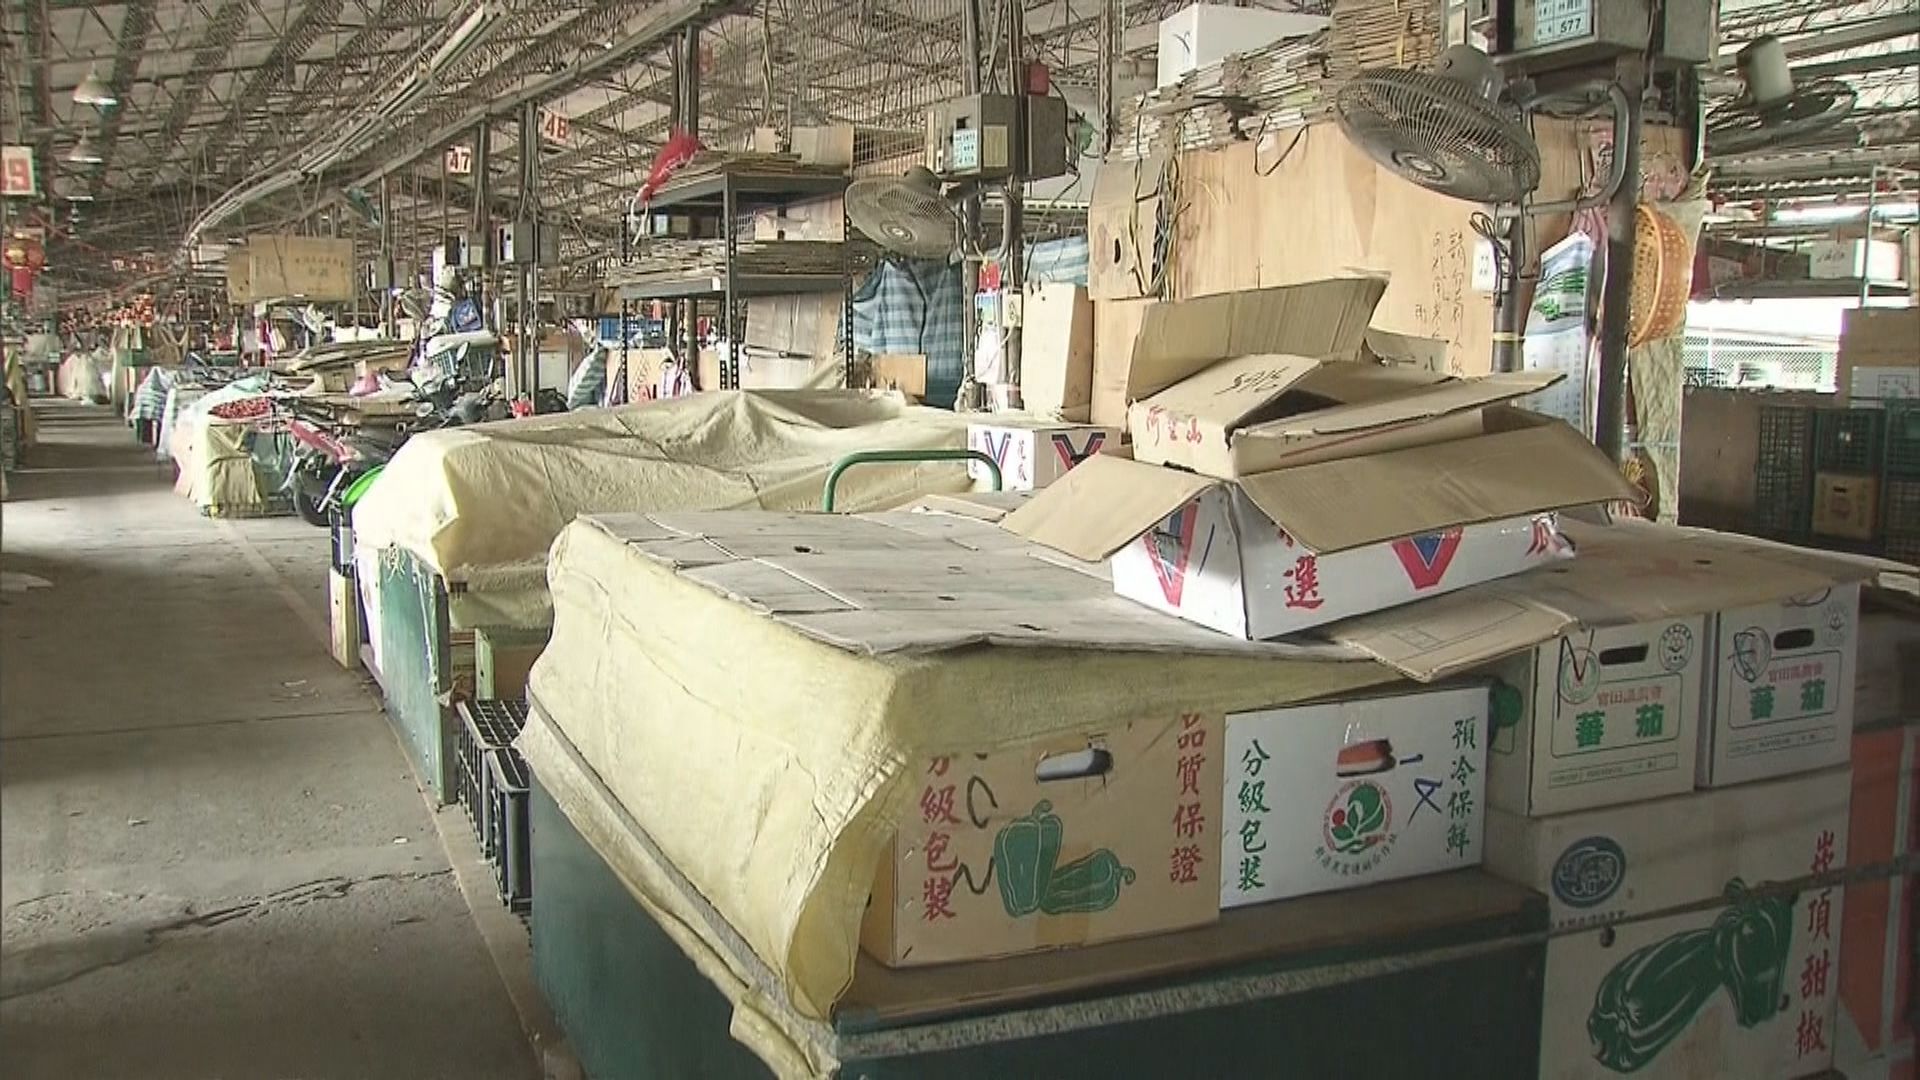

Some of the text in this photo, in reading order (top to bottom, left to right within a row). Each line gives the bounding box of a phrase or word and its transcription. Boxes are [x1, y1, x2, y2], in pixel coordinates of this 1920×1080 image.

[1, 157, 31, 191] 9
[449, 150, 470, 170] 47
[1169, 713, 1206, 884] 品質保證
[1238, 738, 1271, 891] 分級包裝
[1446, 716, 1476, 858] 預冷保鮮
